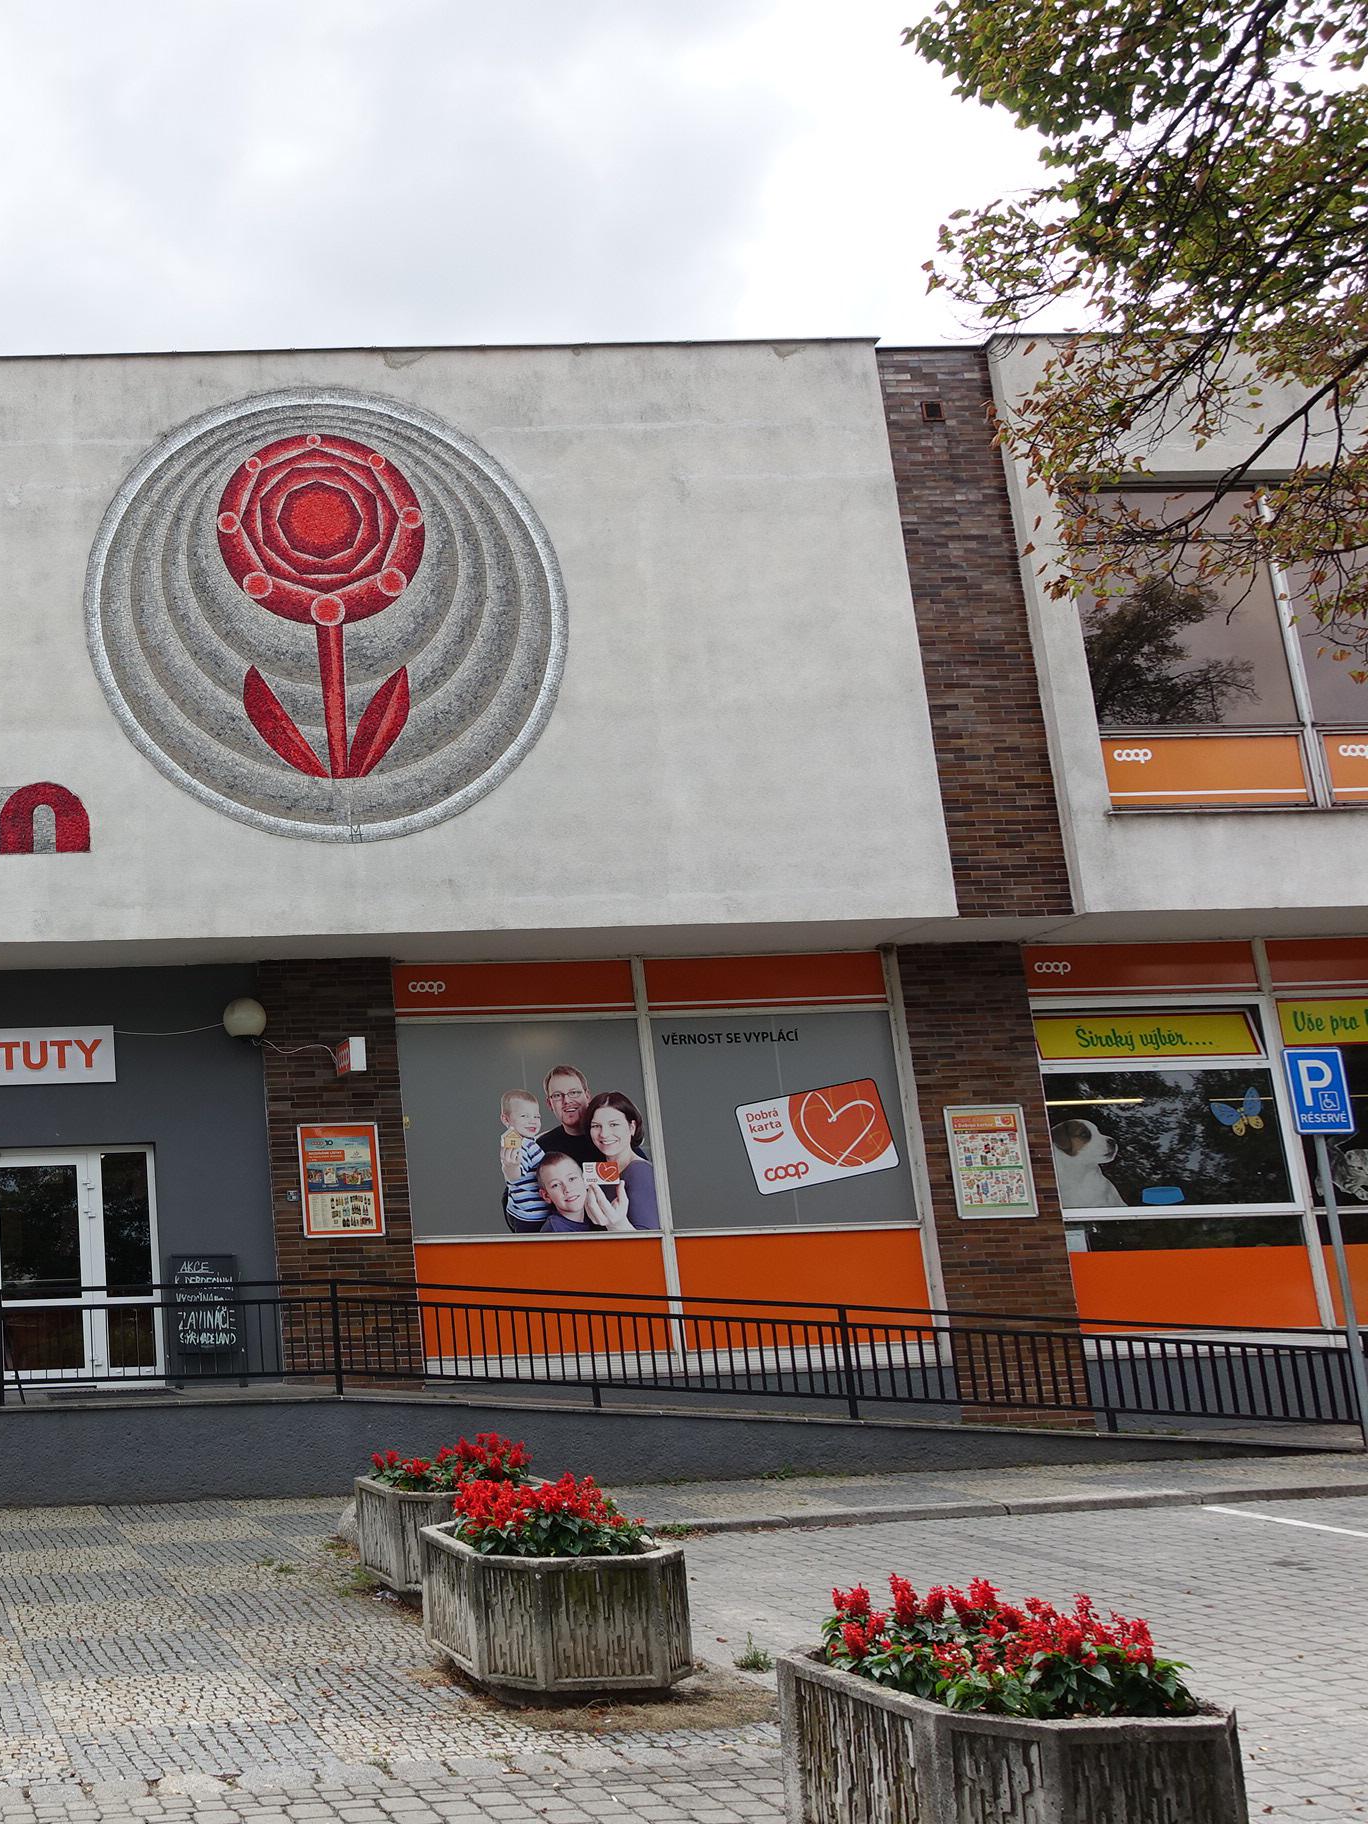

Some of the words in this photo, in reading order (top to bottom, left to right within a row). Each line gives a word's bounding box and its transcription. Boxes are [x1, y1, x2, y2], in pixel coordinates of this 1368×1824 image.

[1113, 748, 1152, 763] coop
[1338, 744, 1368, 759] coo
[1034, 961, 1071, 975] coop
[408, 980, 446, 995] coop
[1293, 1010, 1325, 1032] Vše
[1329, 1014, 1360, 1036] pro
[662, 1032, 722, 1045] VĚRNOST
[726, 1032, 741, 1044] SE
[743, 1028, 799, 1043] VYPLÁCÍ
[1075, 1025, 1135, 1051] Široký
[1297, 1060, 1333, 1106] P
[745, 1107, 779, 1122] Dobrá
[1300, 1111, 1348, 1123] RÉSERVÉ
[748, 1120, 782, 1133] karta
[764, 1161, 809, 1182] coop
[179, 1260, 210, 1273] AKCE
